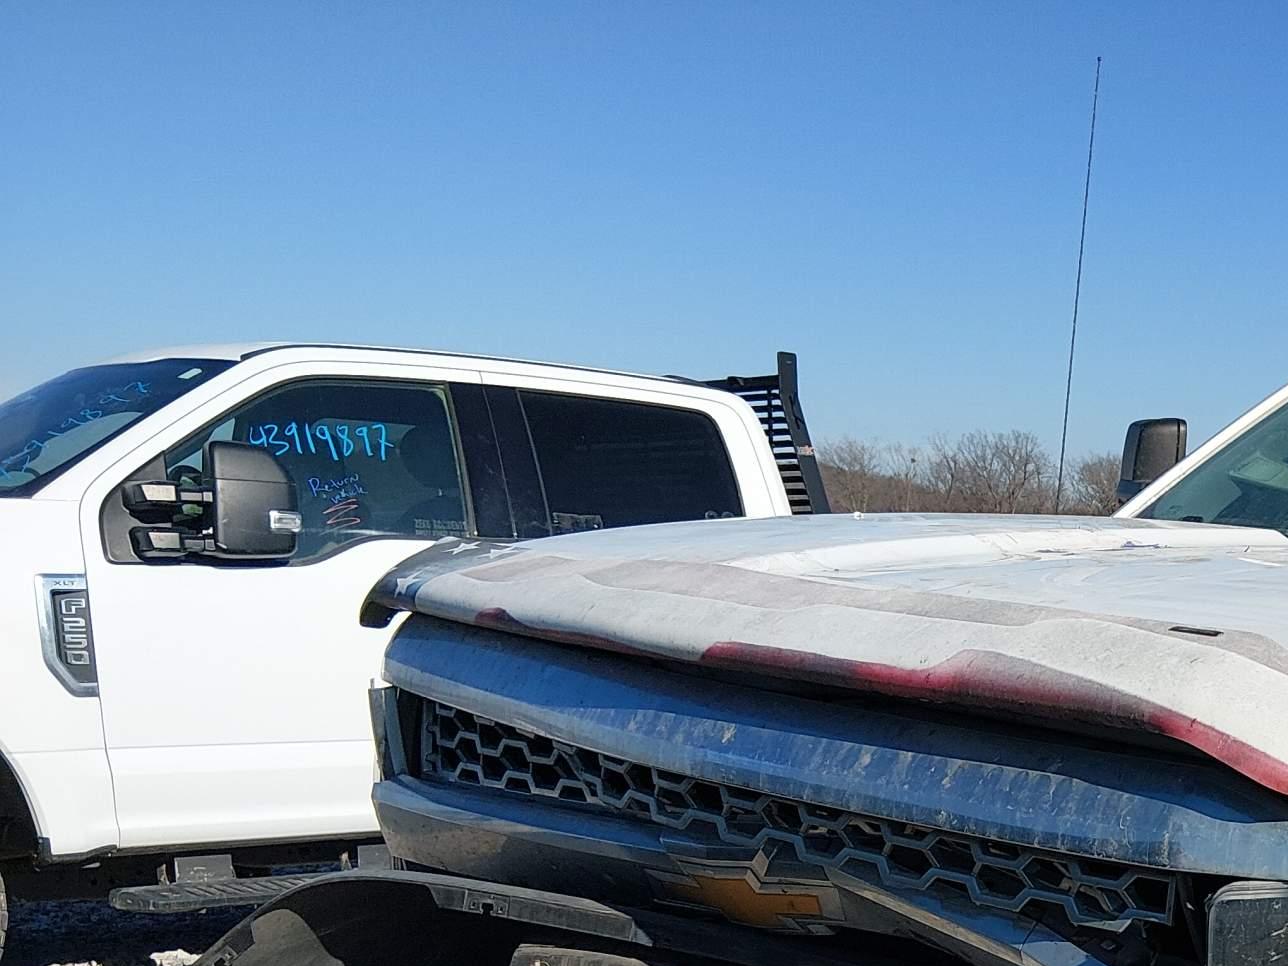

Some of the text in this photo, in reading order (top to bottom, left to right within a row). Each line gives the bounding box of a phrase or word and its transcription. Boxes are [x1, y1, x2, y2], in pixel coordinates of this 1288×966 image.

[249, 422, 394, 461] 43919897
[308, 473, 360, 497] Return
[60, 597, 90, 665] F250
